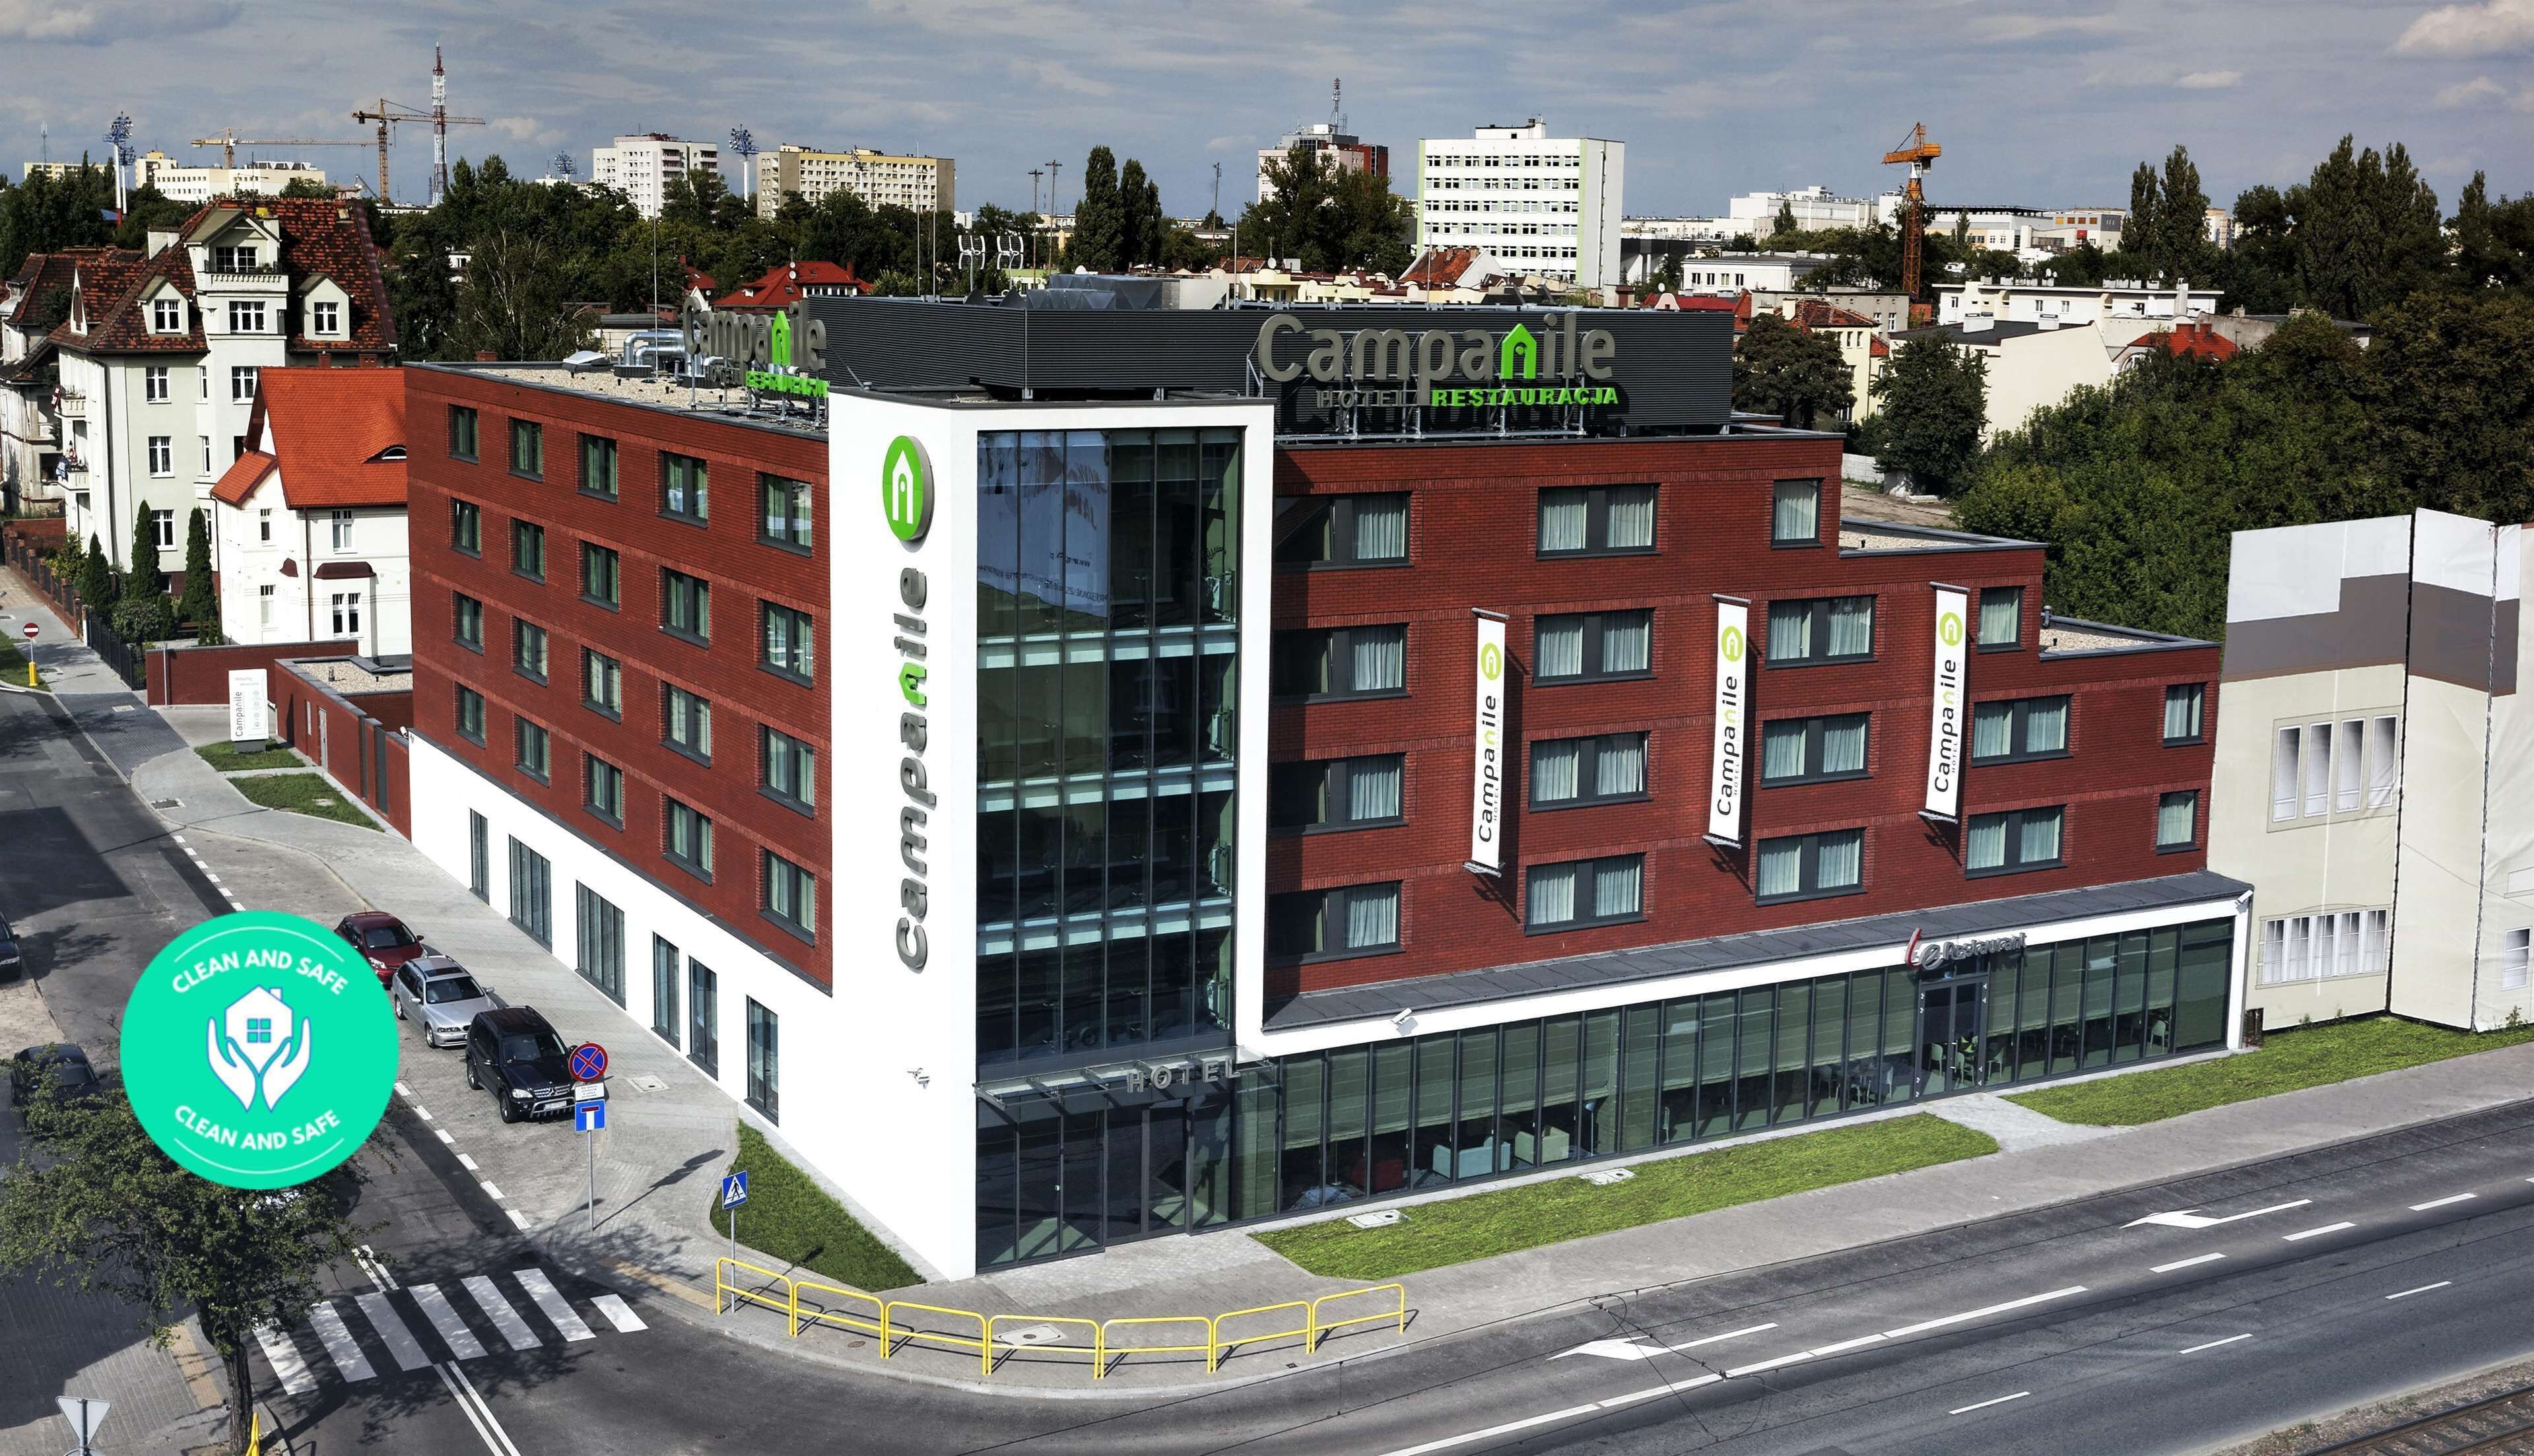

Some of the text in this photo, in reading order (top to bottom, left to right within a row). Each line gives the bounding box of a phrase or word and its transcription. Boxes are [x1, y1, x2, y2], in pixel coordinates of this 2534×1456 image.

[1258, 313, 1616, 405] Campanile
[1316, 387, 1618, 408] HOTEL RESTAURACJA
[234, 691, 246, 737] Campanile
[1717, 676, 1740, 816] Campanile
[1934, 659, 1958, 793] Campanile
[894, 568, 936, 974] Campanile
[1479, 694, 1499, 843] Campanile
[1943, 932, 2028, 960] Restaurant
[1127, 1055, 1241, 1093] HOTEL
